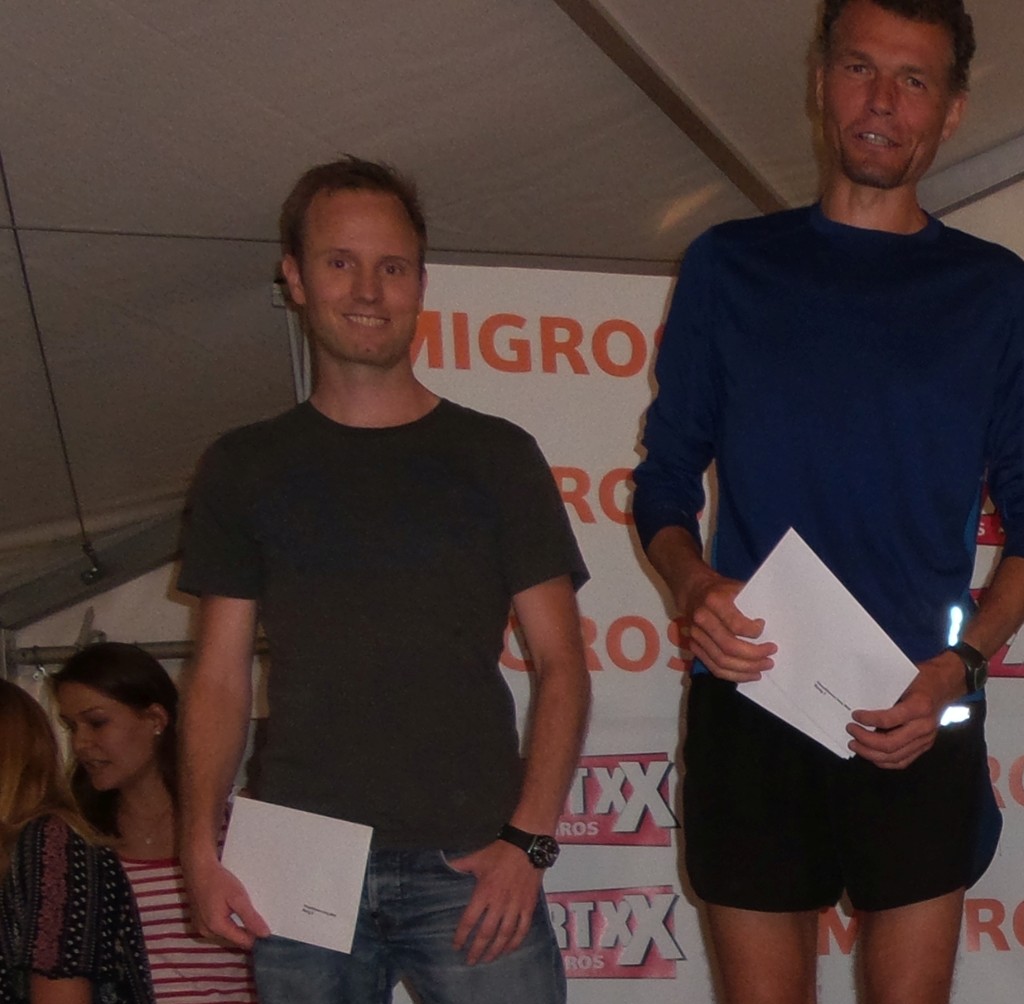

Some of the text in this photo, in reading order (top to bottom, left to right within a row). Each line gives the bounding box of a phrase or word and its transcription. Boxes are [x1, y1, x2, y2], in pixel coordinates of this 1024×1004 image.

[411, 310, 664, 377] MIGRO
[559, 821, 599, 836] ROS
[565, 955, 604, 970] ROS
